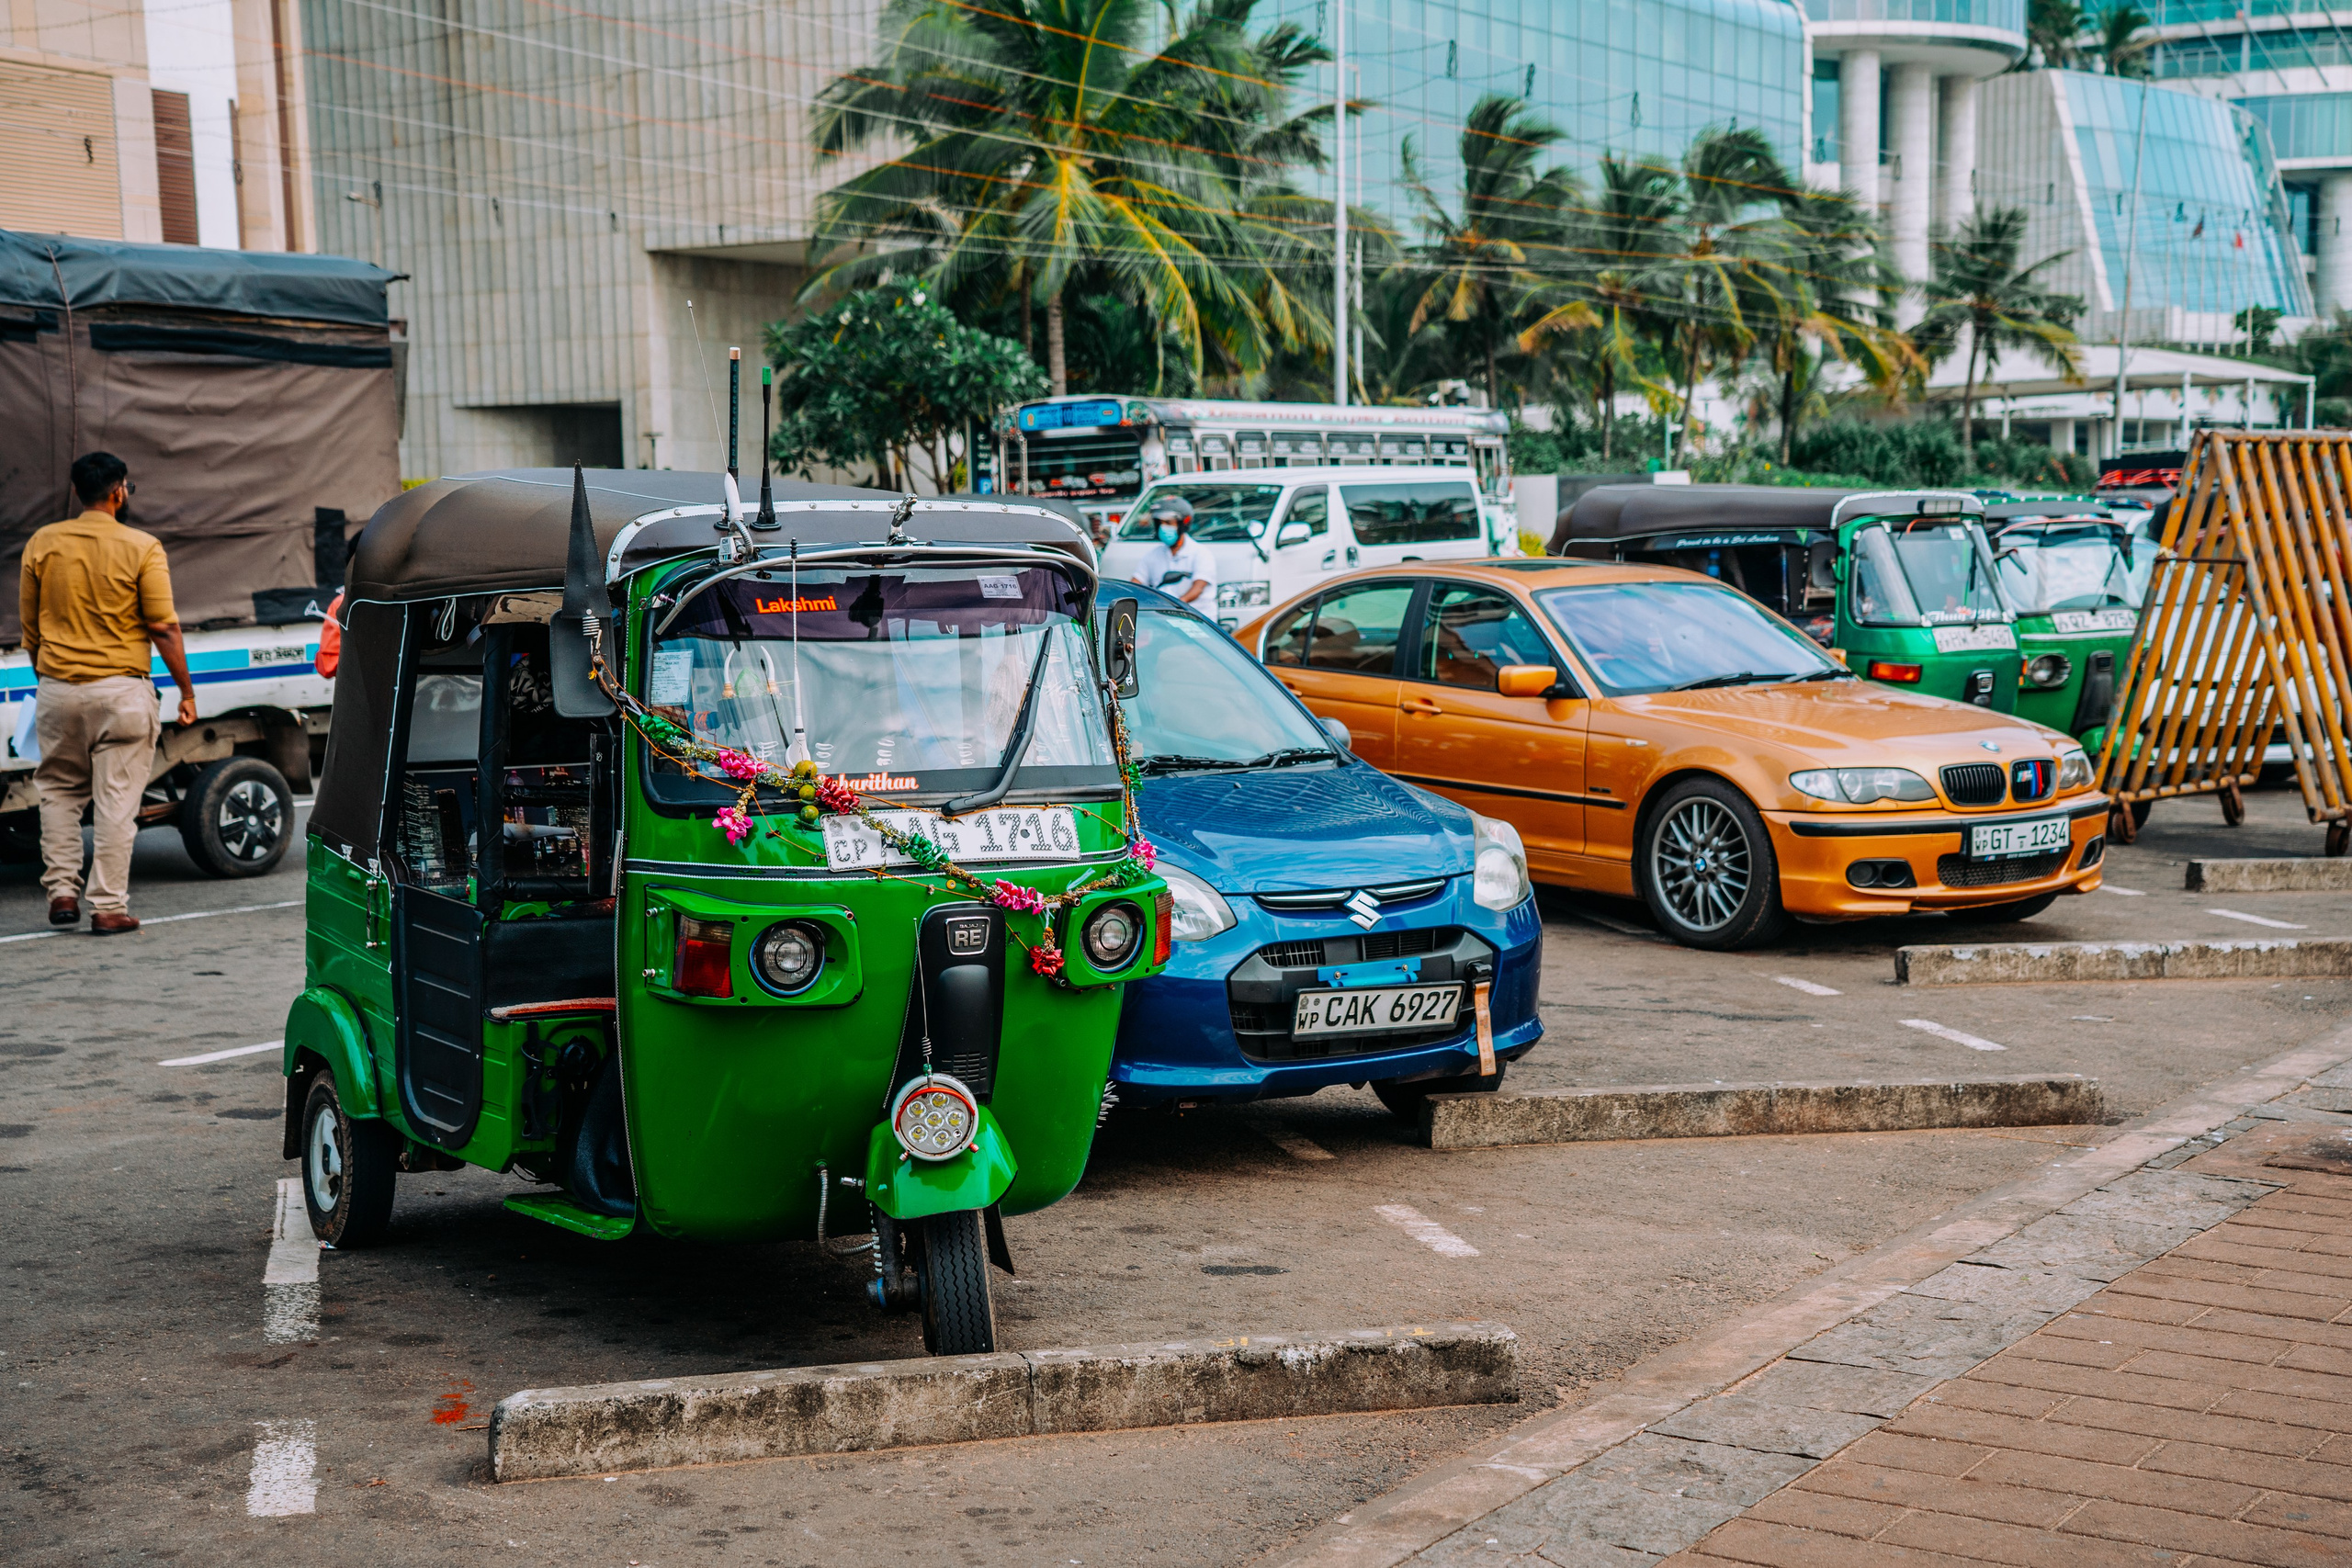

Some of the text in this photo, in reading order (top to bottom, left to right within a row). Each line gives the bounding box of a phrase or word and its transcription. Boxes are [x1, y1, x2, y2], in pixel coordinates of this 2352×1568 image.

[755, 595, 837, 614] Lakshmi
[833, 839, 867, 863] CP
[975, 813, 1074, 852] 1716
[1974, 840, 1988, 852] WP
[2030, 821, 2066, 847] 1234
[955, 929, 982, 947] RE
[1297, 989, 1458, 1030] WP CAK 6927
